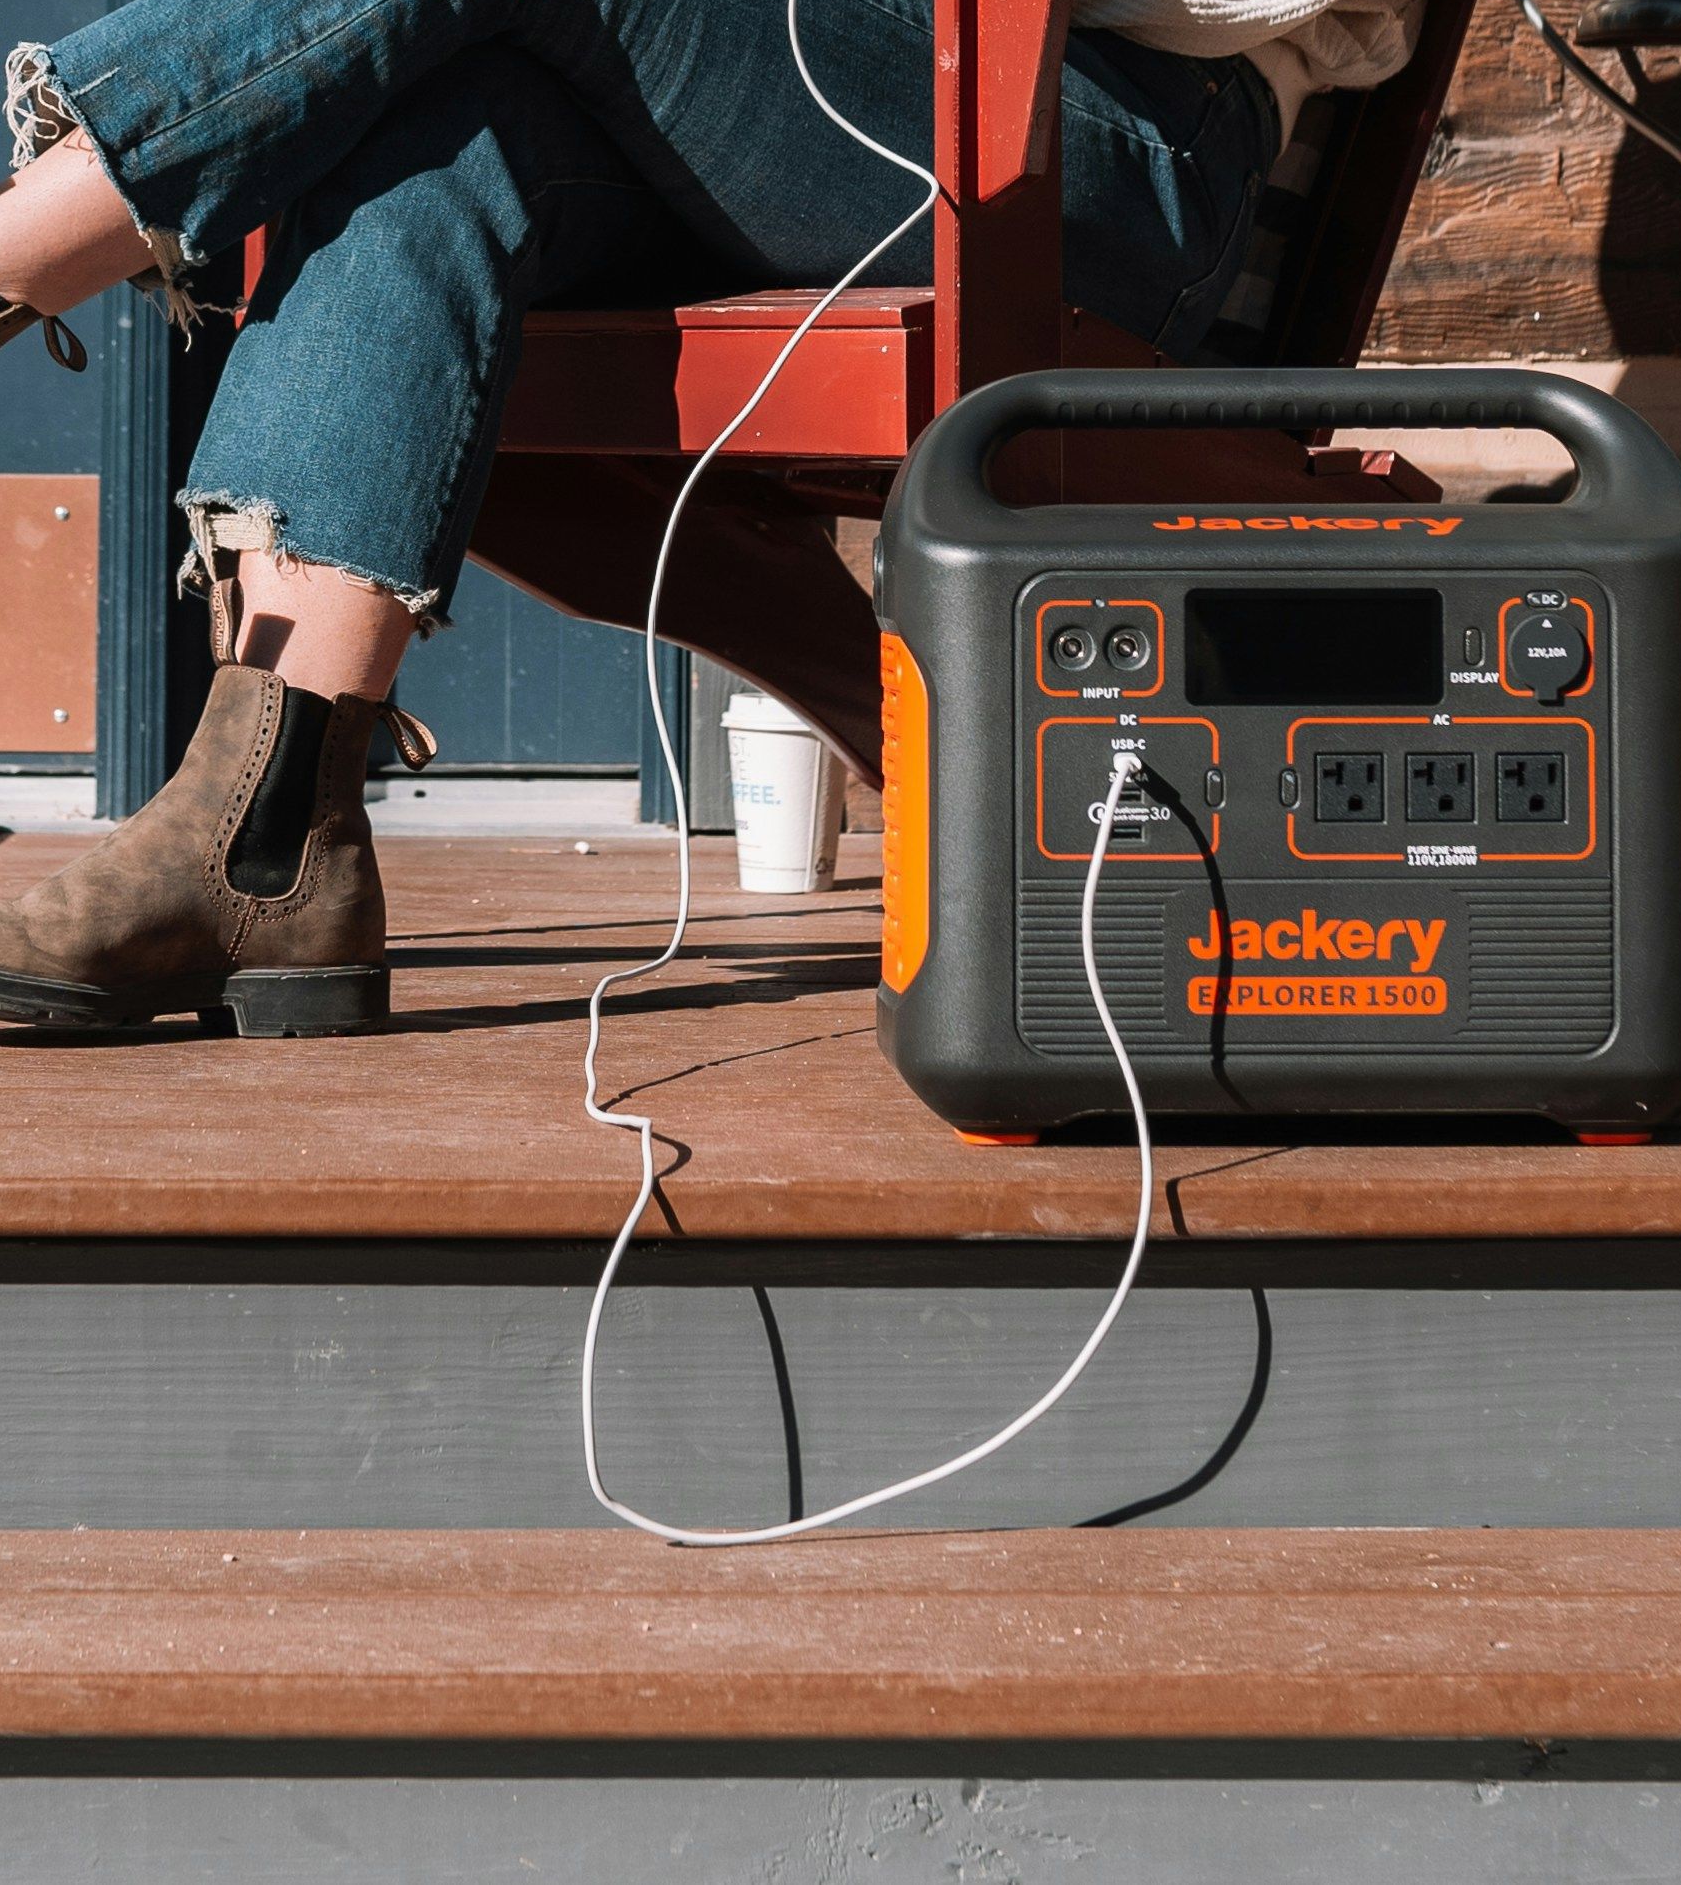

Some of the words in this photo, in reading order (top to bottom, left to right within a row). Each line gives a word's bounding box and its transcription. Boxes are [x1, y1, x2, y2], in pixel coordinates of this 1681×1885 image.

[1153, 516, 1463, 536] Jackery
[1541, 594, 1559, 605] DC
[1450, 672, 1500, 683] DISPLAY
[1082, 687, 1120, 699] INPUT
[1120, 714, 1137, 726] DC
[1432, 713, 1450, 726] AC
[1111, 739, 1146, 750] USB-C
[1150, 807, 1171, 821] 3.0
[1187, 909, 1447, 972] Jackery
[1198, 985, 1357, 1007] EXPLORER
[1366, 985, 1437, 1007] 1500
